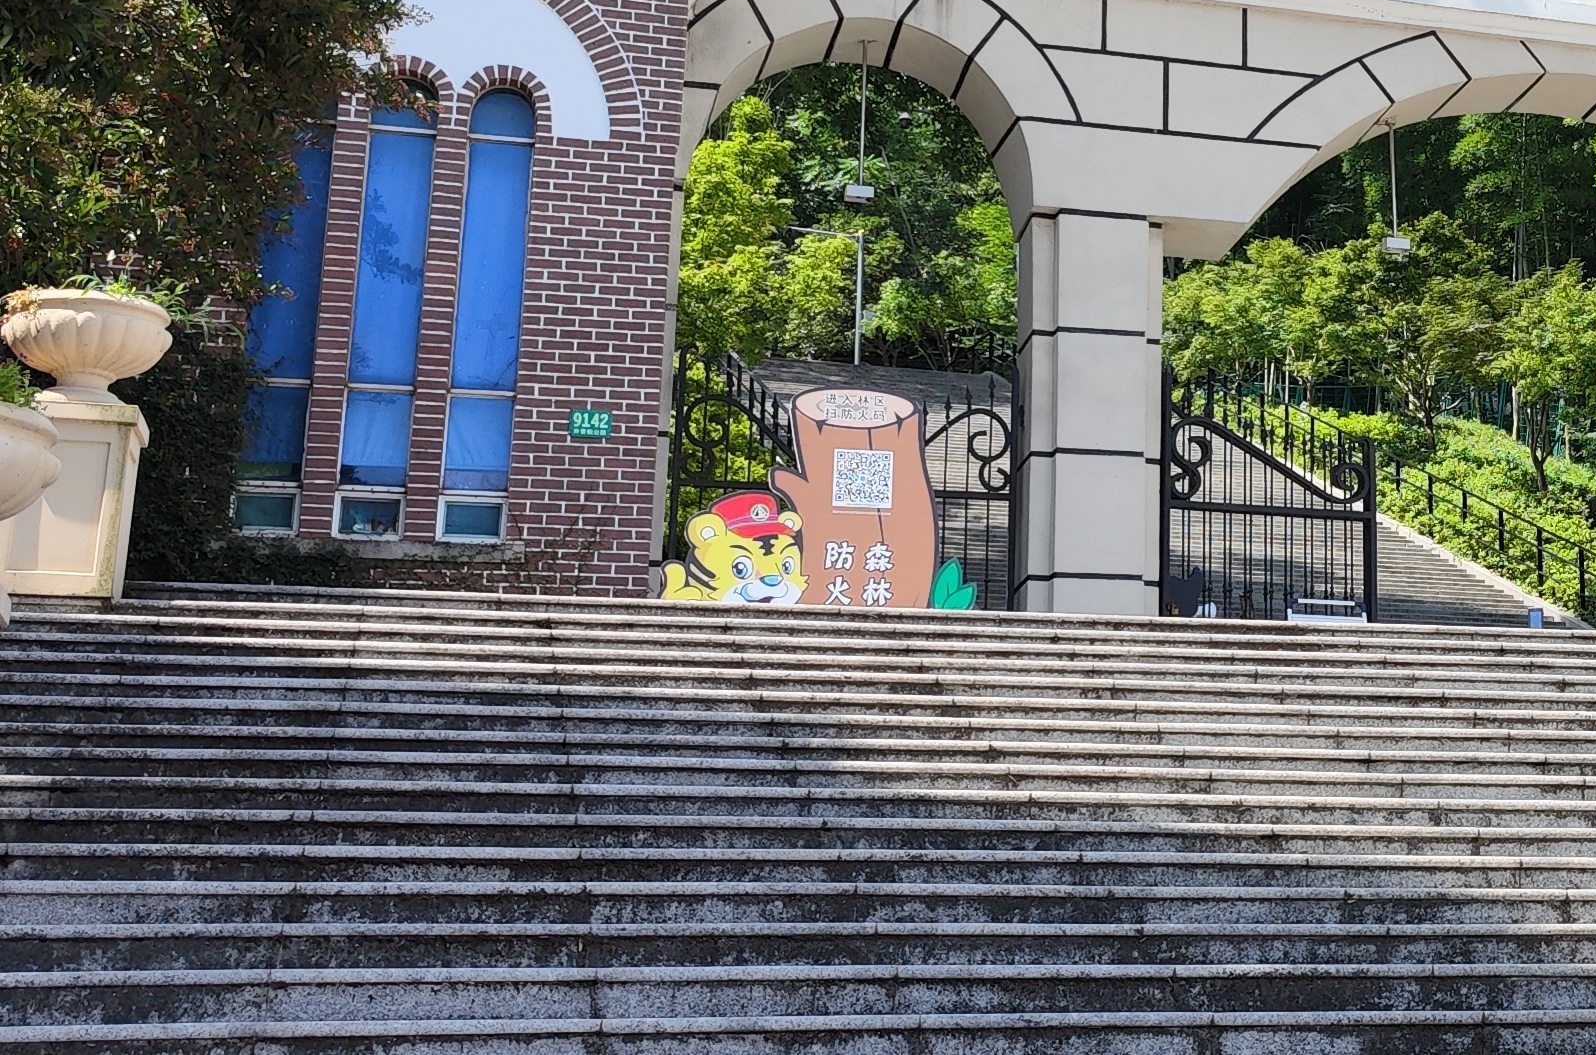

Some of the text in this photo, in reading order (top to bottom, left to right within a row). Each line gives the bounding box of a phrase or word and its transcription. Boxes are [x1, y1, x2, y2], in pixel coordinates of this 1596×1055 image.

[824, 393, 887, 406] 进入林区
[573, 412, 609, 429] 9142
[824, 407, 886, 421] 扫防火码
[823, 541, 855, 605] 防火
[863, 542, 895, 606] 森林
